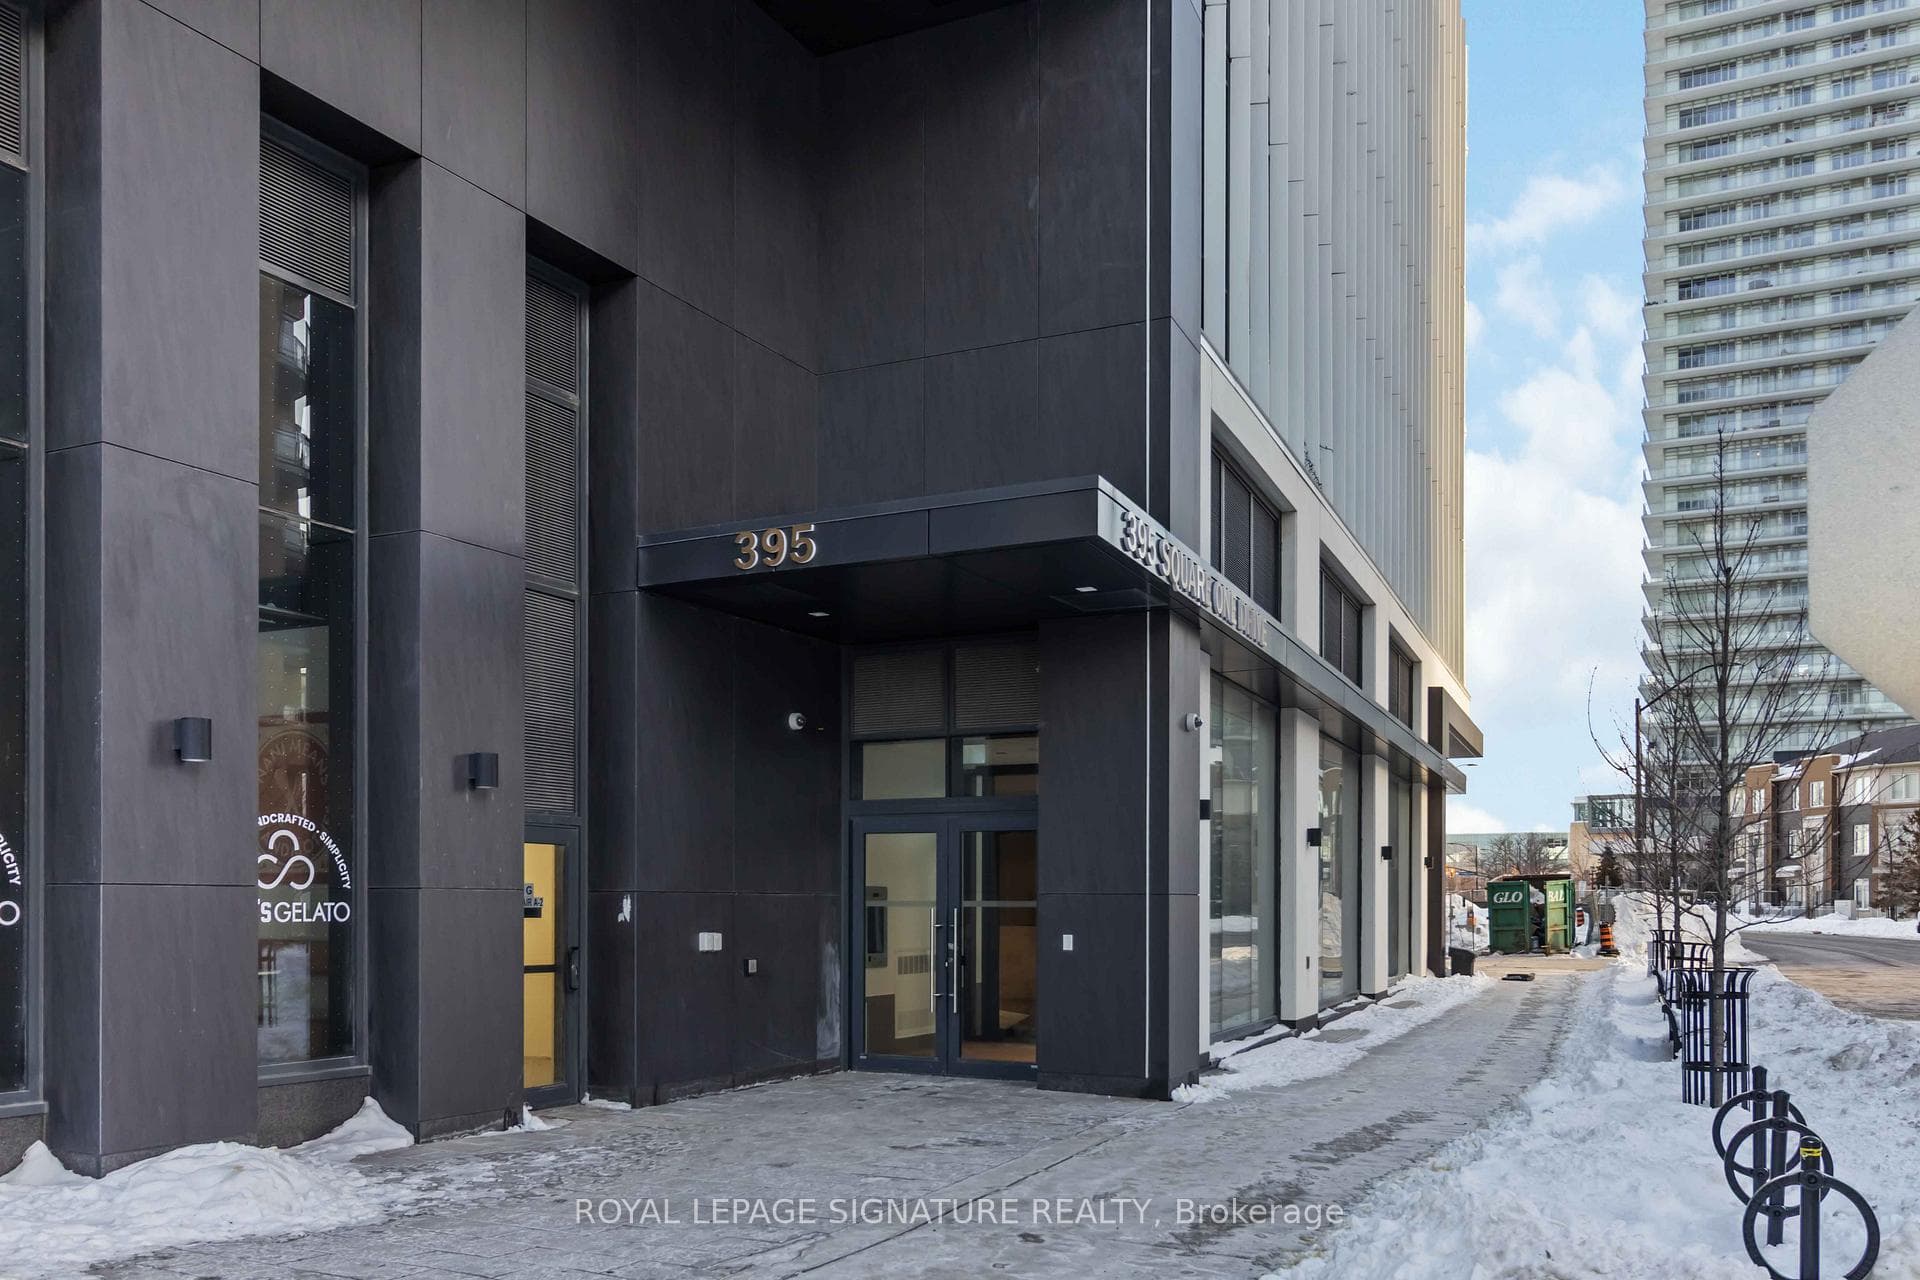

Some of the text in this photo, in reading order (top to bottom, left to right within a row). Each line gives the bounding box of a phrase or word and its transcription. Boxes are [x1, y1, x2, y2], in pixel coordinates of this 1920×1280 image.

[735, 524, 816, 570] 395
[1120, 511, 1156, 567] 395
[319, 831, 351, 890] SIMPLICITY
[274, 901, 351, 923] GELATO
[1493, 891, 1523, 904] GLO
